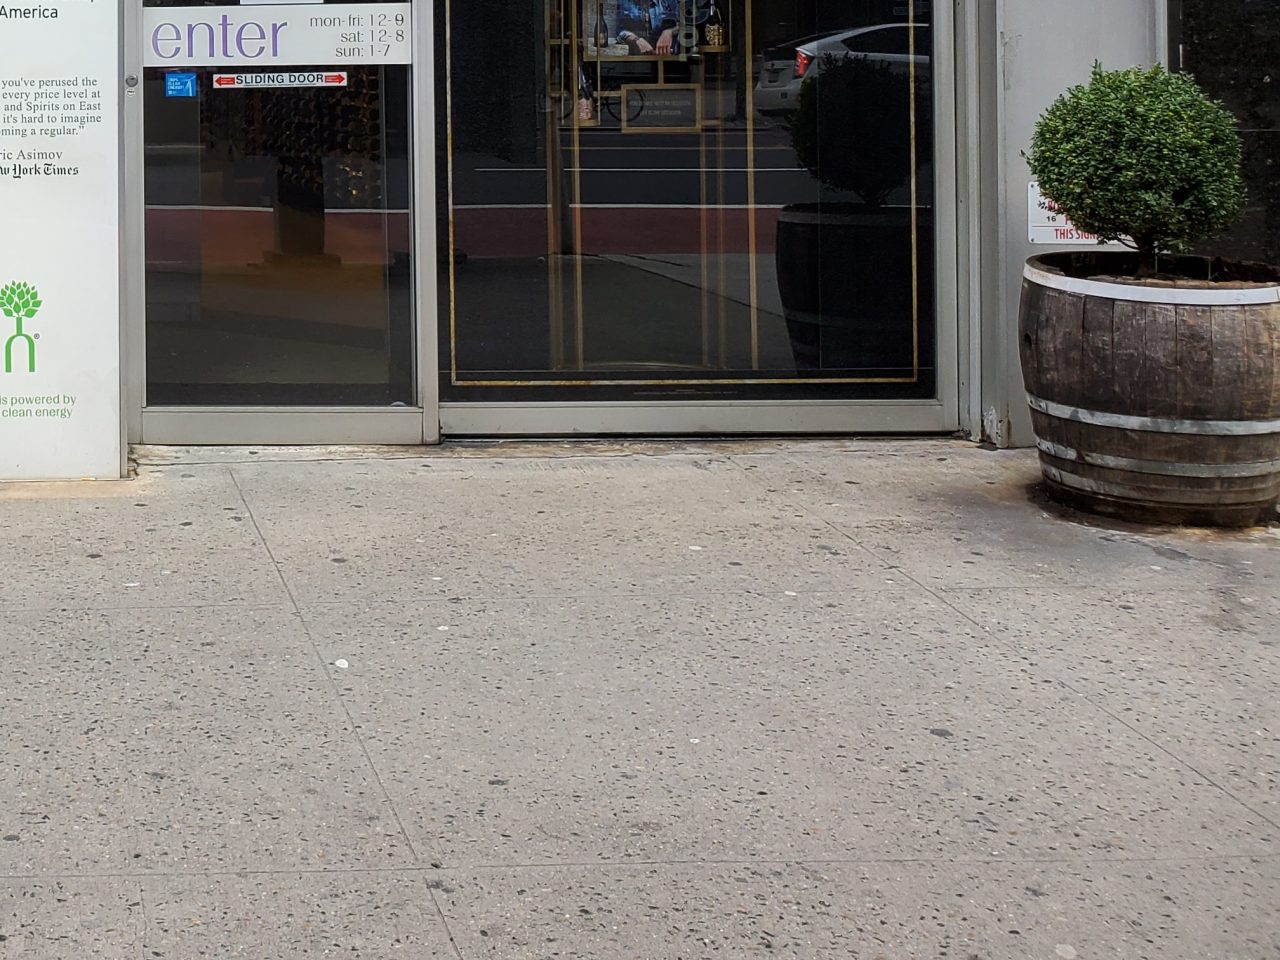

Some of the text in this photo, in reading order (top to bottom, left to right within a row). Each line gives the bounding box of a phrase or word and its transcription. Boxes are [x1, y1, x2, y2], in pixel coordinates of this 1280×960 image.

[151, 14, 287, 59] enter
[340, 31, 364, 43] sat:
[335, 45, 364, 57] sun:
[2, 77, 35, 89] you've
[39, 77, 78, 89] perused
[81, 77, 98, 86] the
[236, 73, 324, 85] SLIDING DOOR
[2, 91, 31, 101] every
[34, 90, 60, 101] price
[63, 89, 88, 99] level
[91, 90, 101, 99] at
[4, 102, 22, 111] and
[26, 101, 60, 113] Spirits
[63, 103, 76, 111] on
[79, 101, 101, 111] East
[3, 114, 18, 124] it's
[21, 114, 44, 124] hard
[47, 114, 57, 123] to
[60, 113, 102, 125] imagine
[30, 128, 36, 136] a
[17, 148, 63, 160] Asimov
[12, 163, 41, 179] York
[43, 162, 79, 176] Times
[1054, 228, 1074, 240] THIS
[0, 395, 8, 405] is
[10, 394, 60, 406] powered
[62, 394, 77, 406] by
[1, 407, 32, 417] clean
[35, 408, 72, 419] energy
